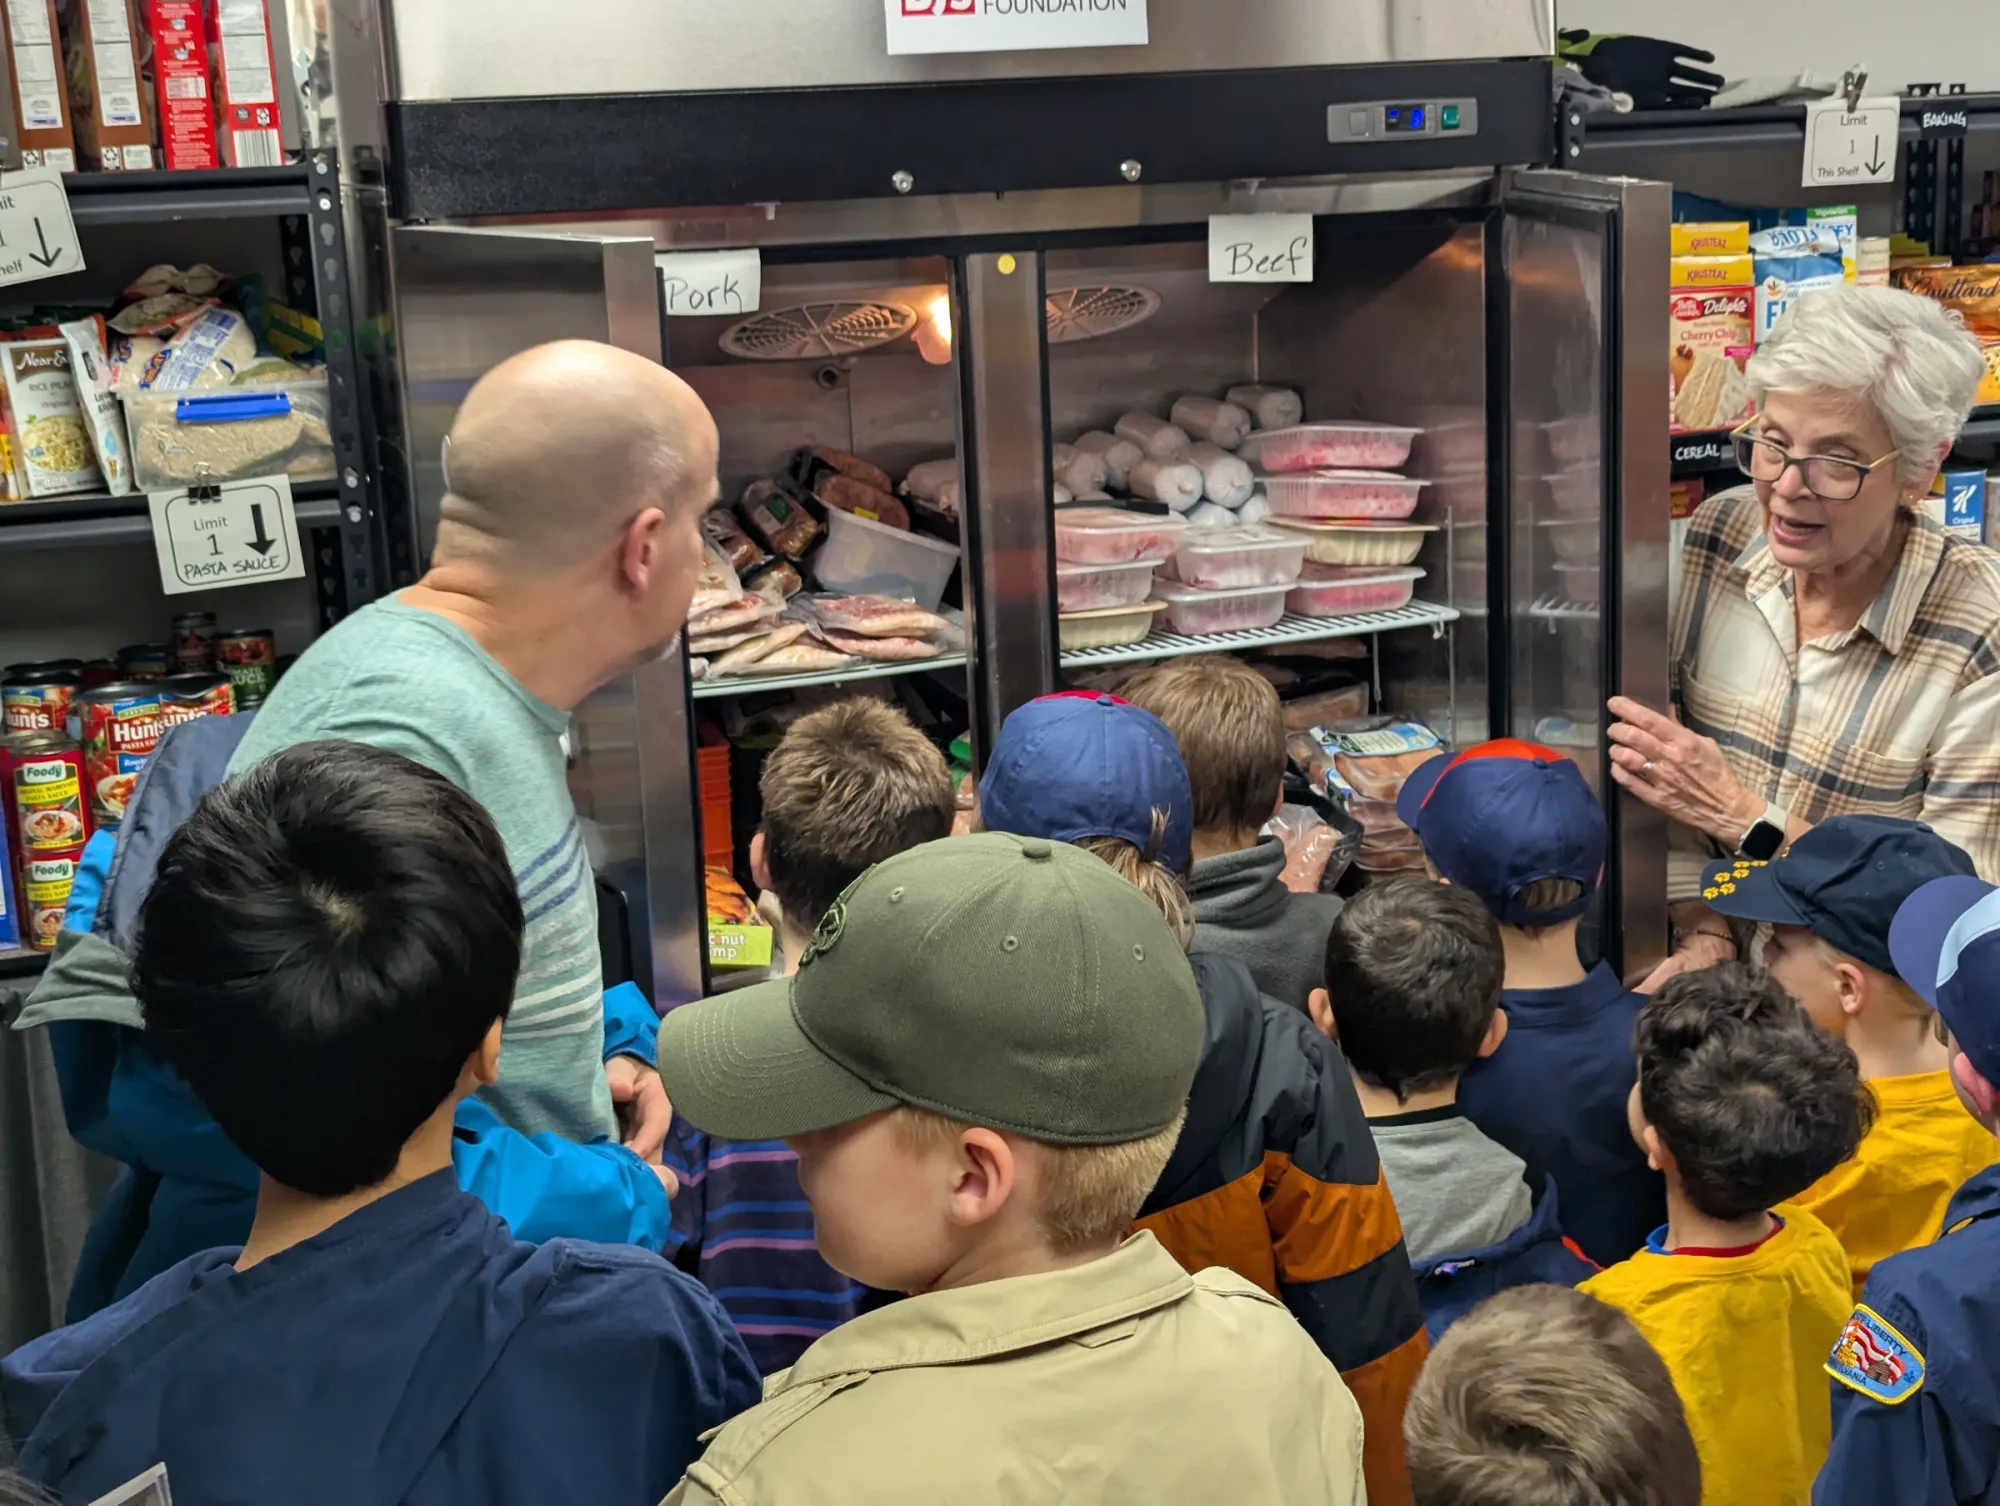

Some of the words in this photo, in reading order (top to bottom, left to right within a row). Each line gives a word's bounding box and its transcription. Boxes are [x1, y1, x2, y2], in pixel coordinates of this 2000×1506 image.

[984, 0, 1127, 15] FOUNDATION
[1840, 115, 1868, 126] Limit
[1923, 112, 1966, 128] BAKING
[1849, 139, 1855, 154] 1
[1817, 168, 1834, 177] This
[1837, 166, 1859, 177] Shelf
[1691, 237, 1727, 250] KRUSTEAZ
[1225, 236, 1308, 276] Beef
[1687, 268, 1727, 282] KRUSTEAZ
[665, 274, 743, 313] Pork
[1704, 297, 1747, 316] Delights
[1680, 331, 1713, 344] Cherry
[1714, 328, 1737, 342] Chip
[17, 352, 52, 370] Near
[1675, 443, 1720, 460] CEREAL
[194, 517, 229, 531] Limit
[207, 533, 224, 555] 1
[184, 561, 227, 579] PASTA
[233, 556, 280, 573] SAUCE
[121, 742, 144, 750] PASTA
[27, 765, 62, 777] Foody
[34, 863, 69, 876] Foody
[1866, 1319, 1907, 1356] LIBERTY
